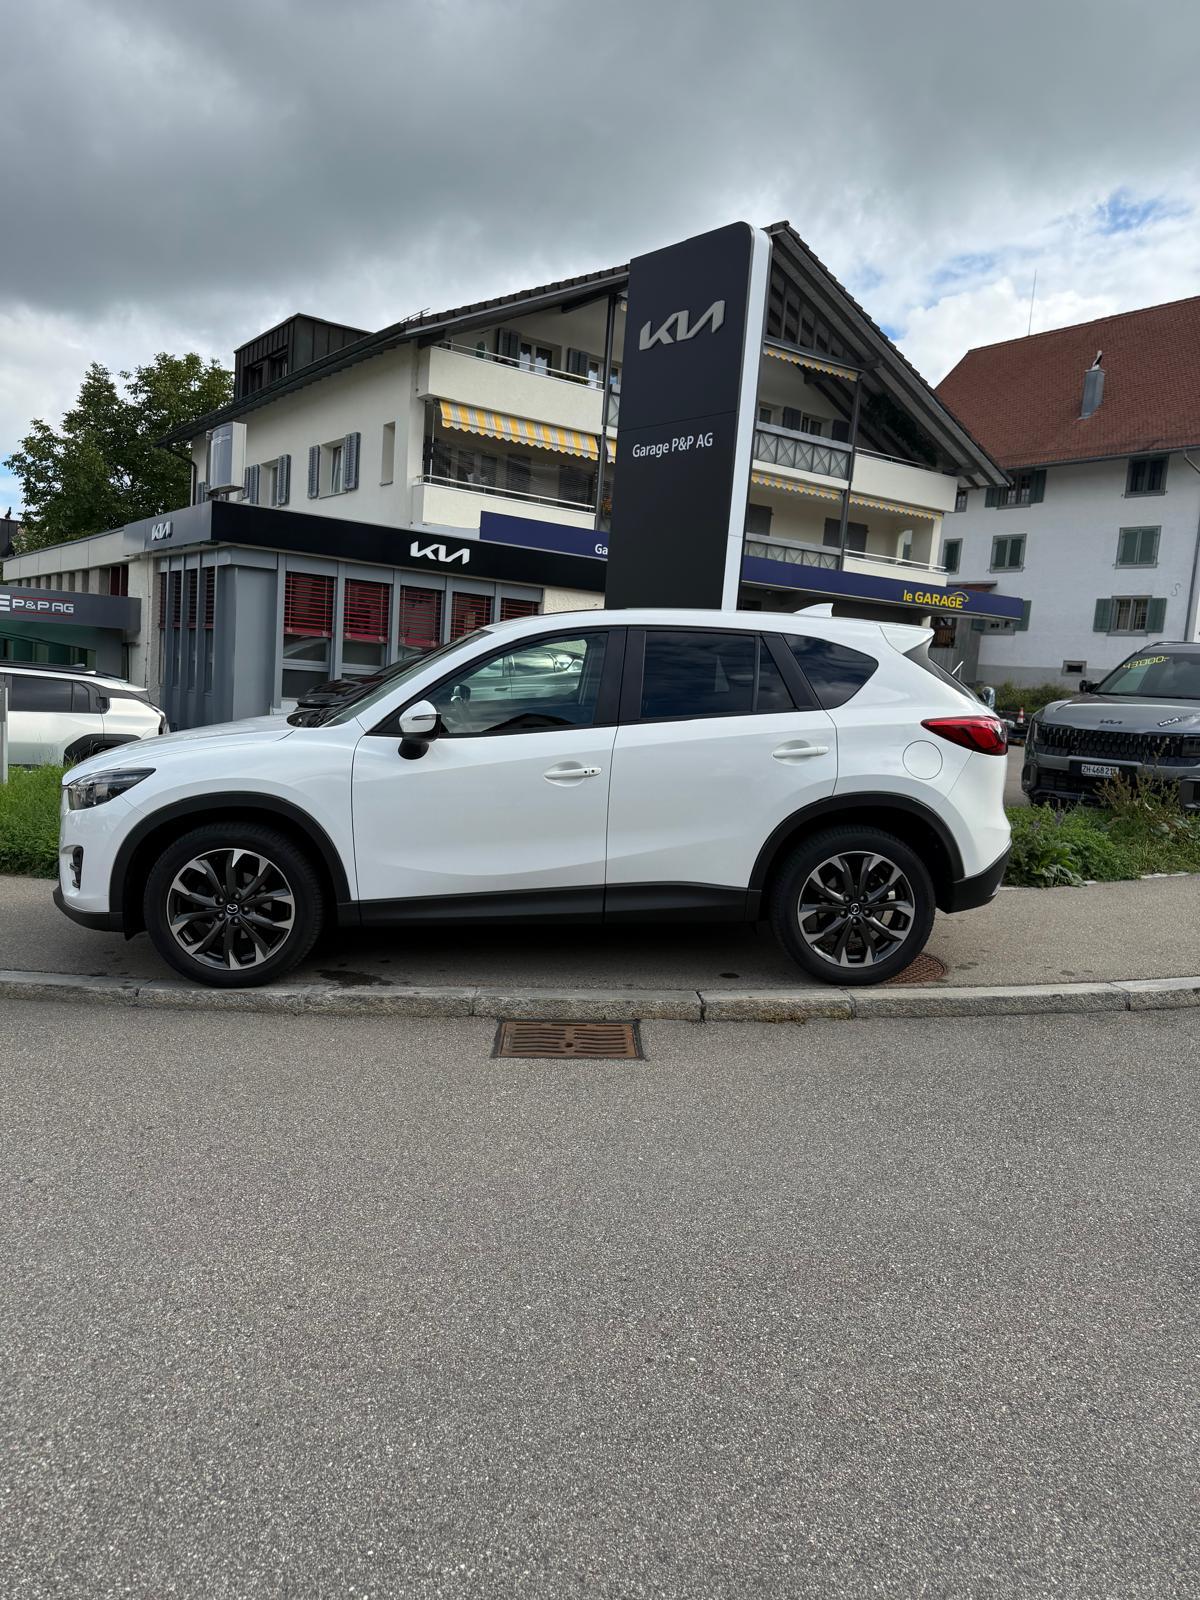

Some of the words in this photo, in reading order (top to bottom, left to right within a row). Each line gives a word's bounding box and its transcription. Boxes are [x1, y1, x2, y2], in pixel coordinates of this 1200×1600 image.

[639, 300, 725, 350] KIA
[632, 442, 669, 458] Garage
[671, 435, 695, 452] P&P
[695, 432, 713, 449] AG
[410, 541, 471, 565] KIA
[12, 598, 50, 611] P&P
[51, 602, 75, 613] AG
[903, 589, 913, 601] le
[915, 591, 964, 609] GARAGE
